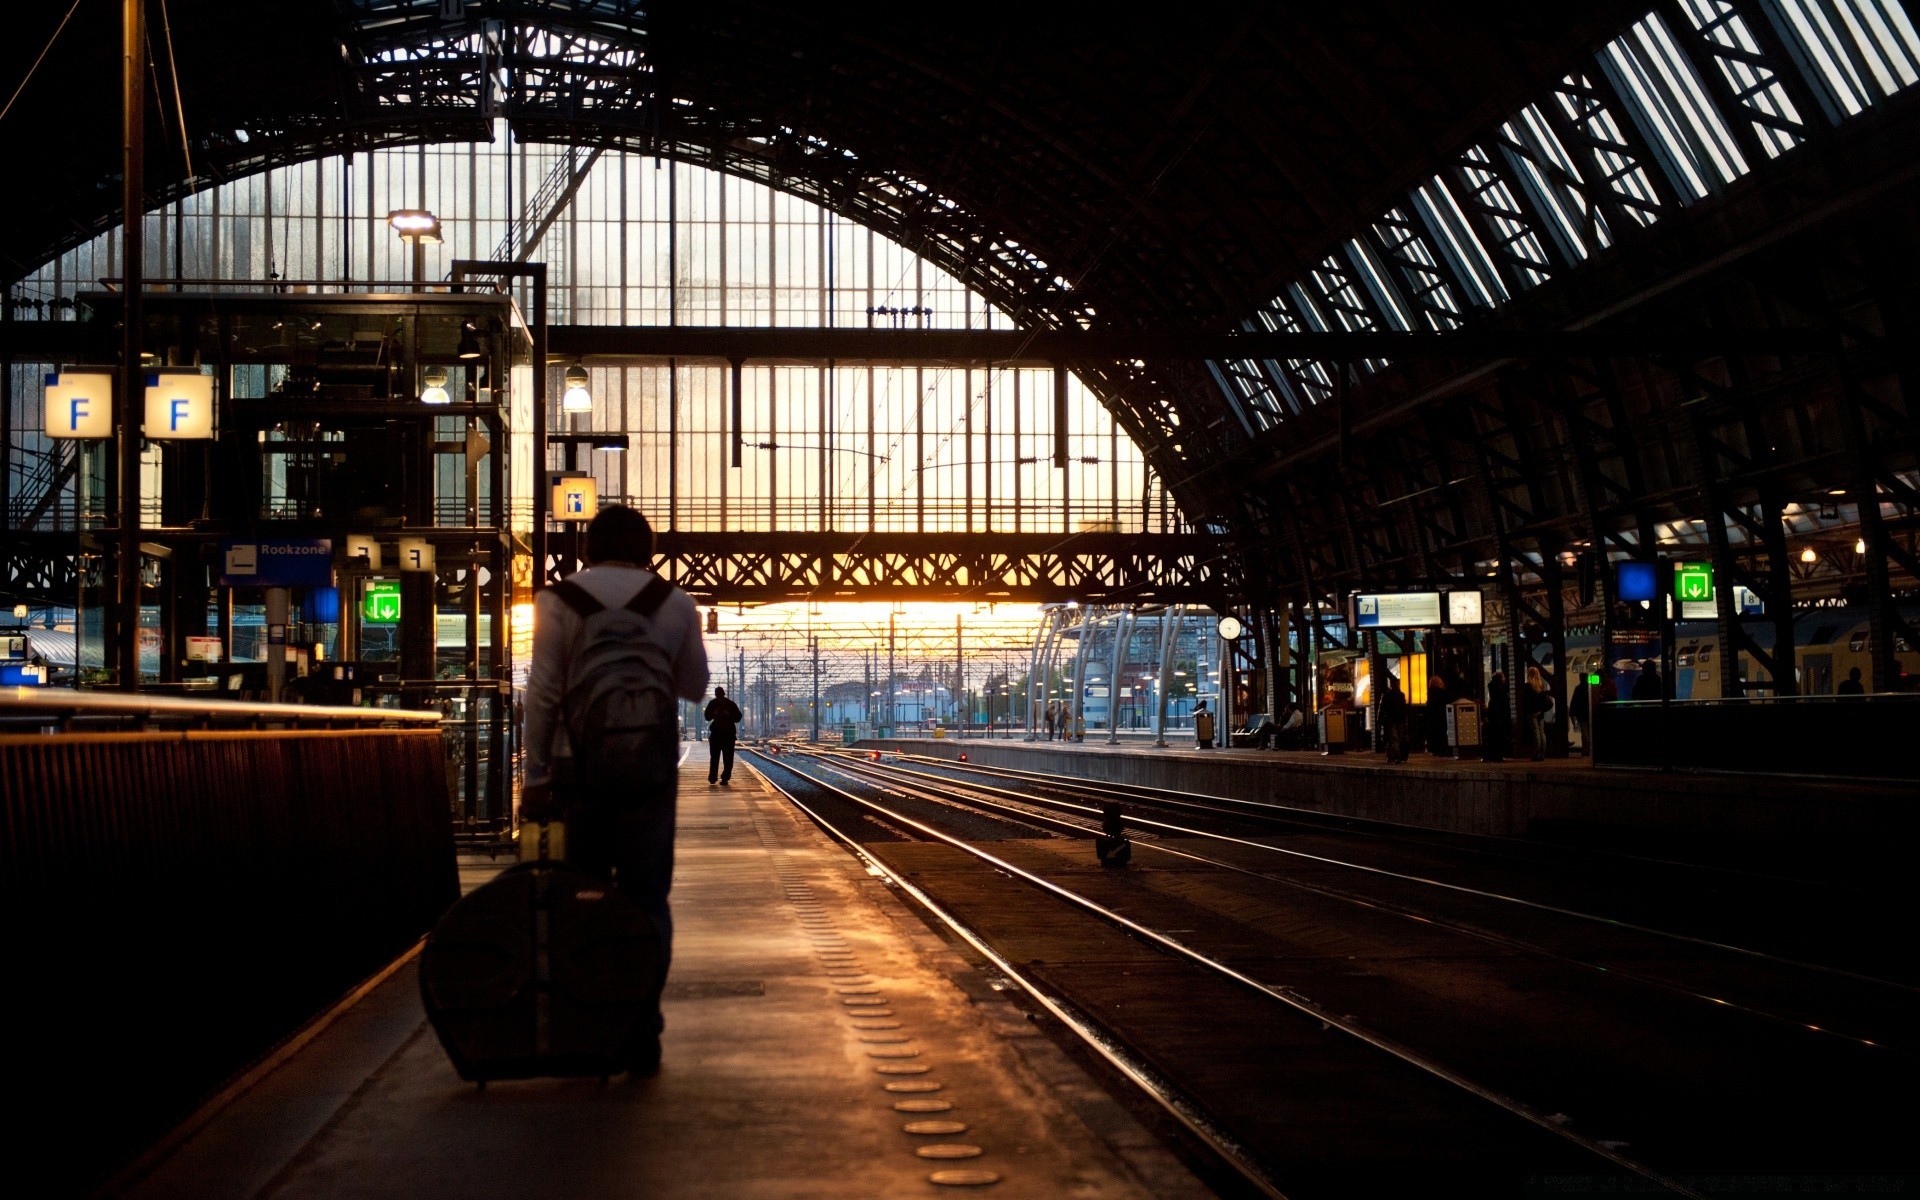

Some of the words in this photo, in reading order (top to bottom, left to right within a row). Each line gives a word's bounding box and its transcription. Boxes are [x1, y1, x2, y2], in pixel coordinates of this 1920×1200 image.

[70, 398, 89, 430] F
[171, 399, 189, 431] F
[261, 544, 326, 555] Rookzone
